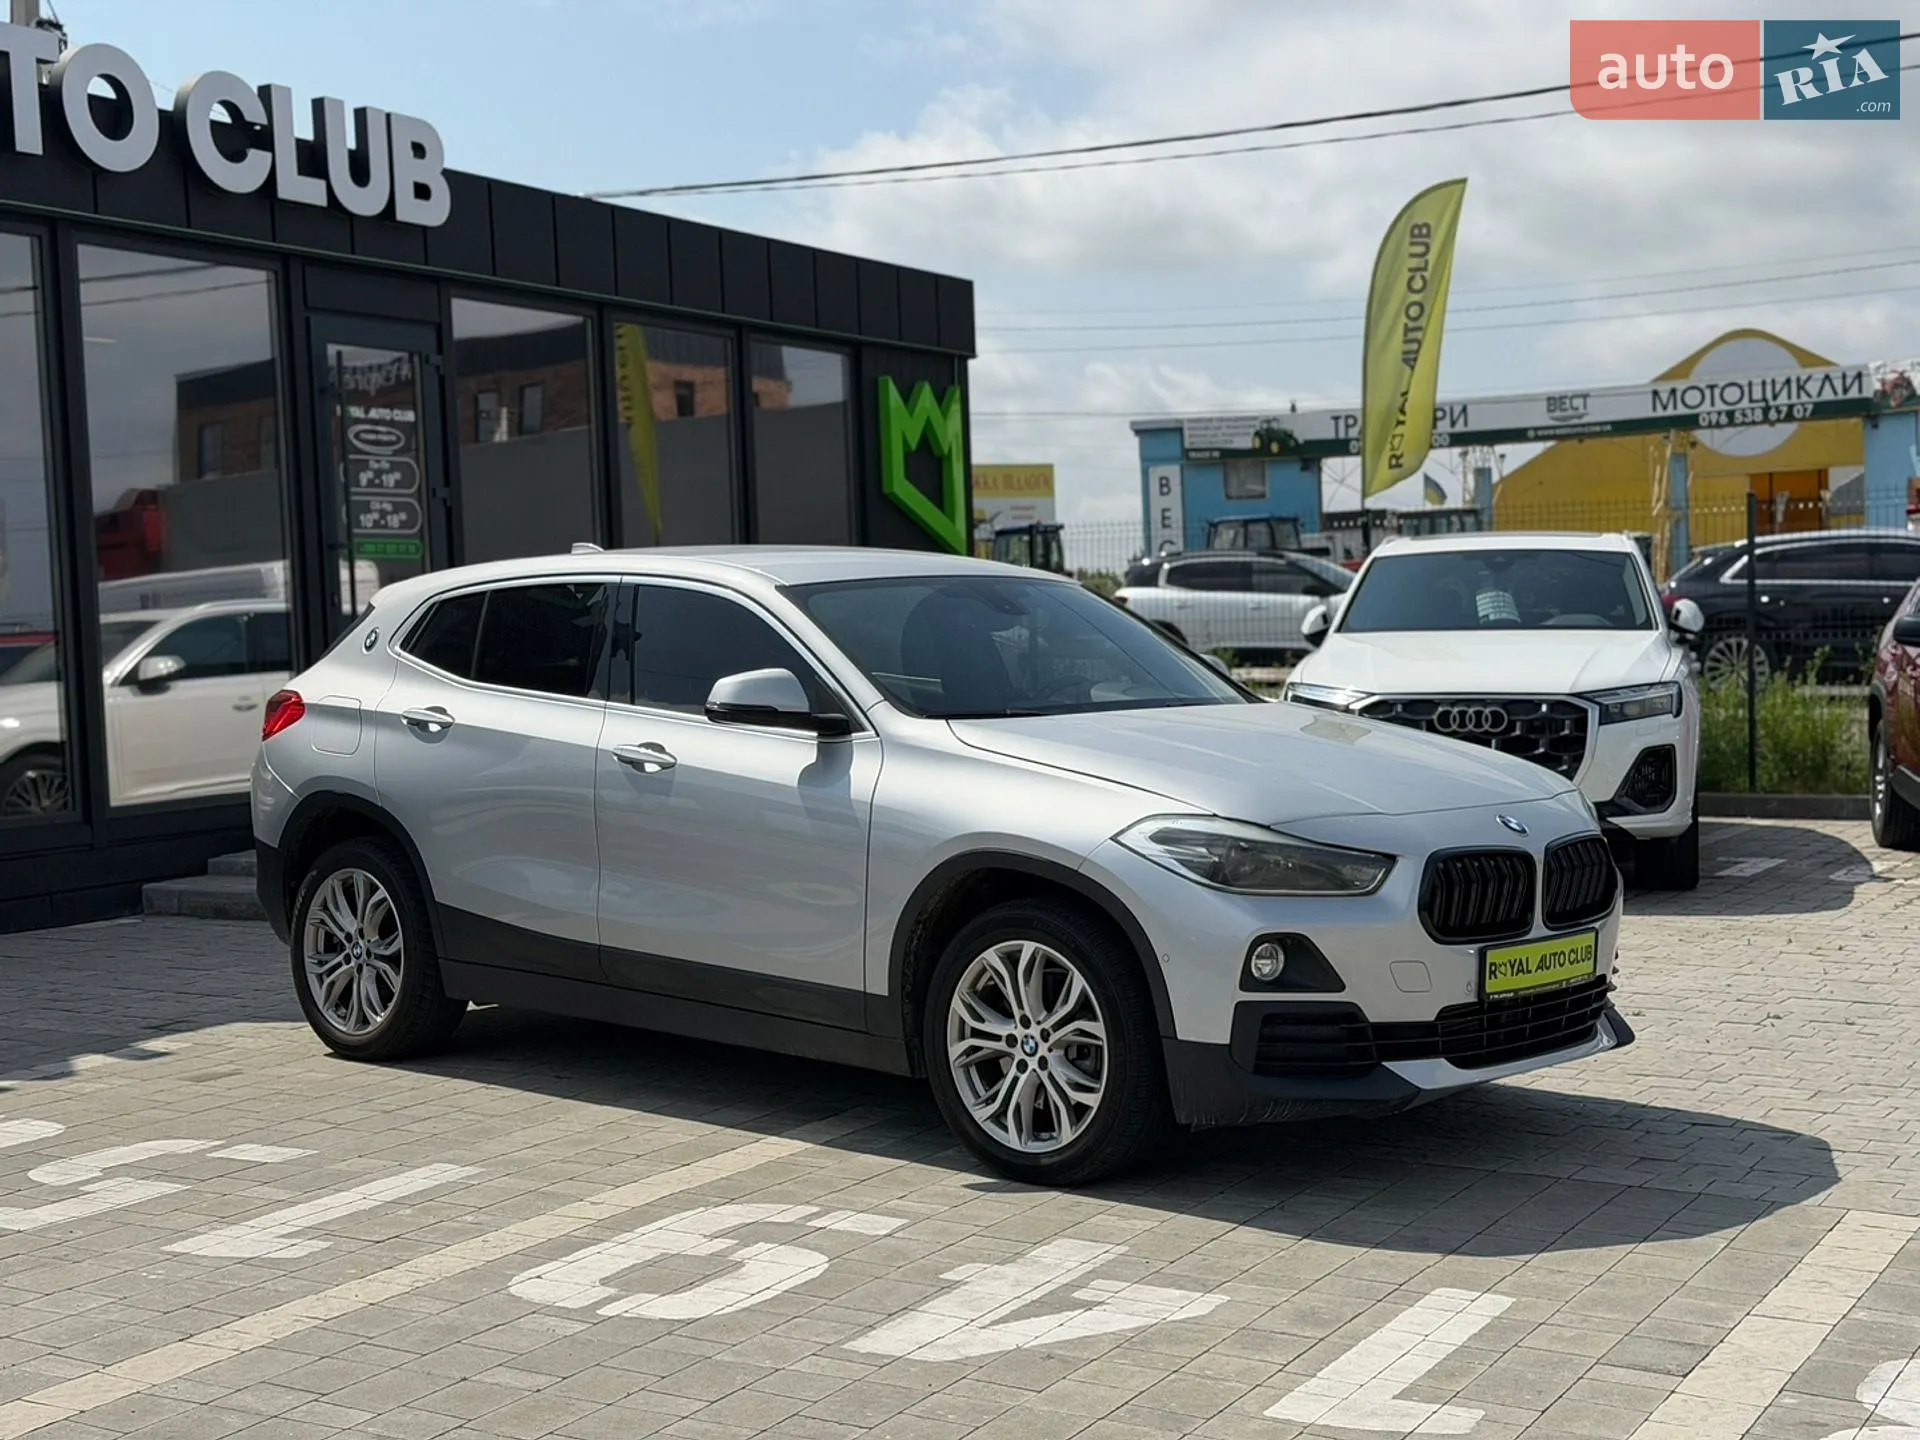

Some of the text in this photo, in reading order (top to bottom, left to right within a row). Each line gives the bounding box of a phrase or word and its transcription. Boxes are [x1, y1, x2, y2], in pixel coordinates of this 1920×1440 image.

[174, 70, 452, 228] CLUB
[1407, 221, 1432, 294] CLUB
[1546, 393, 1591, 413] ВЕСТ
[1651, 370, 1864, 413] МОТОЦИКЛИ
[1698, 403, 1815, 427] 096 538 67 07
[1534, 949, 1567, 974] AUTO
[1567, 944, 1593, 966] CLUB
